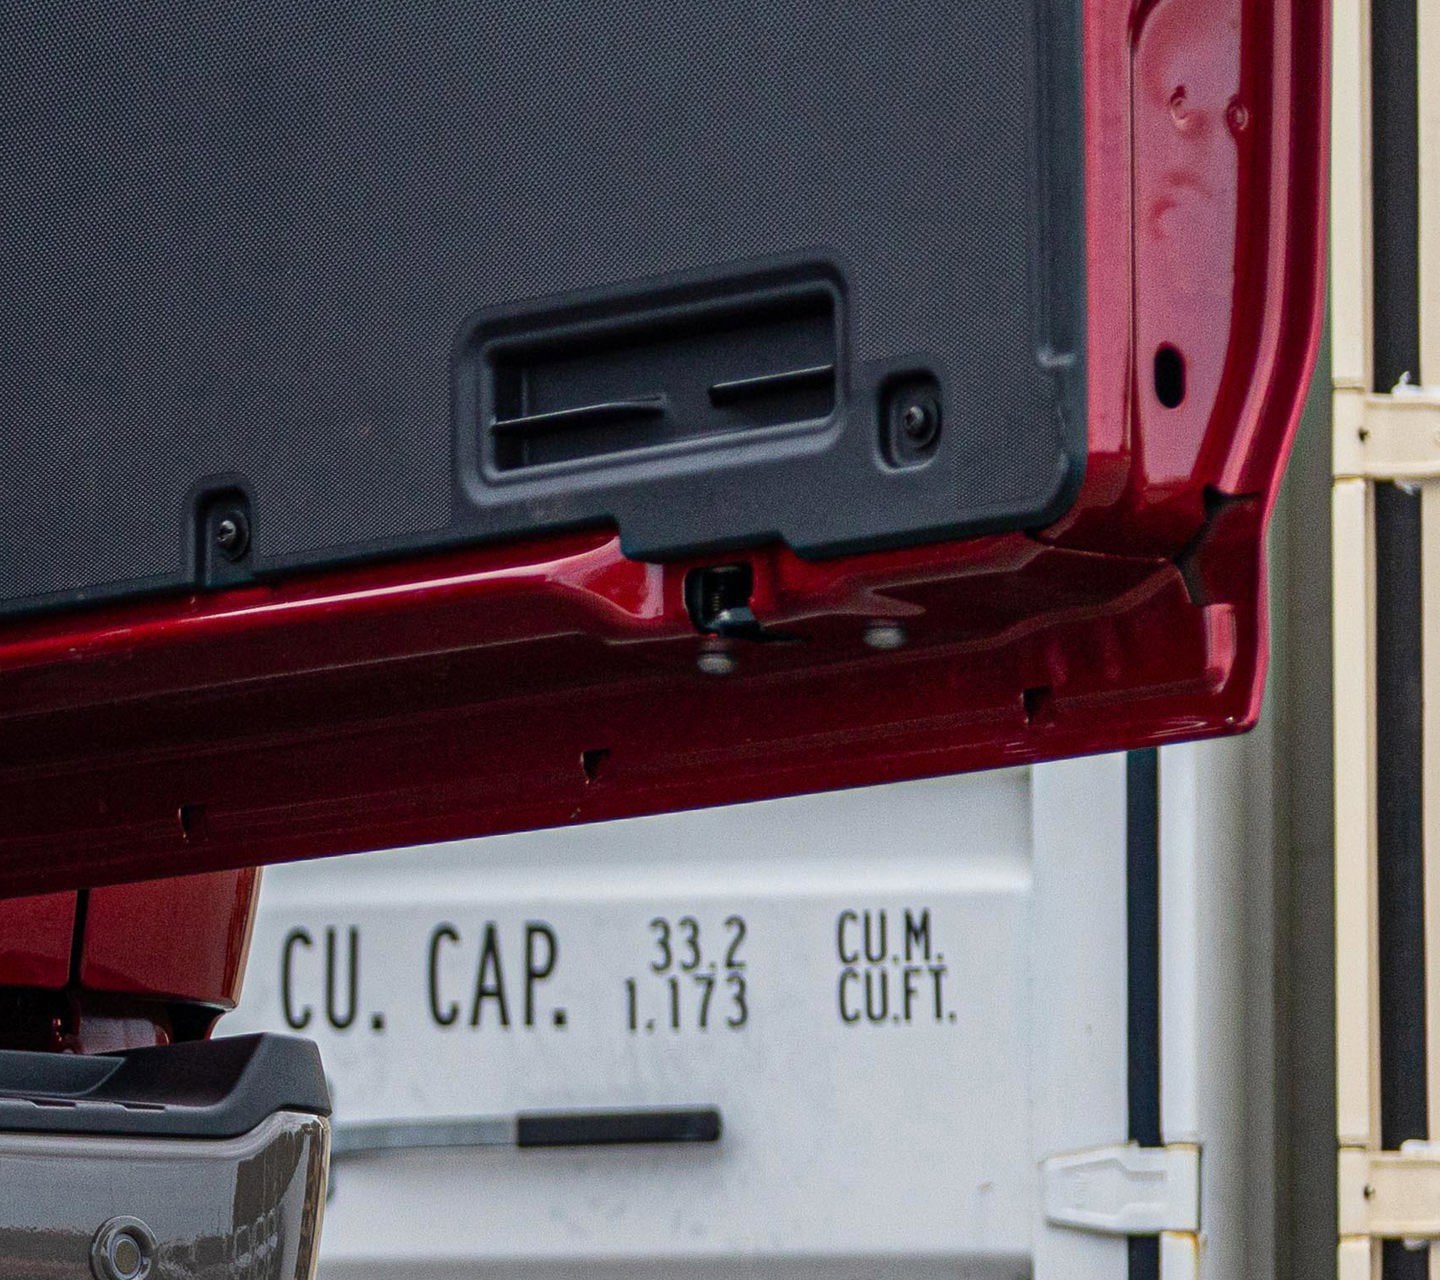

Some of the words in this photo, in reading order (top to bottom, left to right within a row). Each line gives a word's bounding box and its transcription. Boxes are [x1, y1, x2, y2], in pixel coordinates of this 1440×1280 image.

[282, 924, 384, 1030] CU.
[428, 921, 567, 1027] CAP.
[648, 915, 747, 973] 33.2
